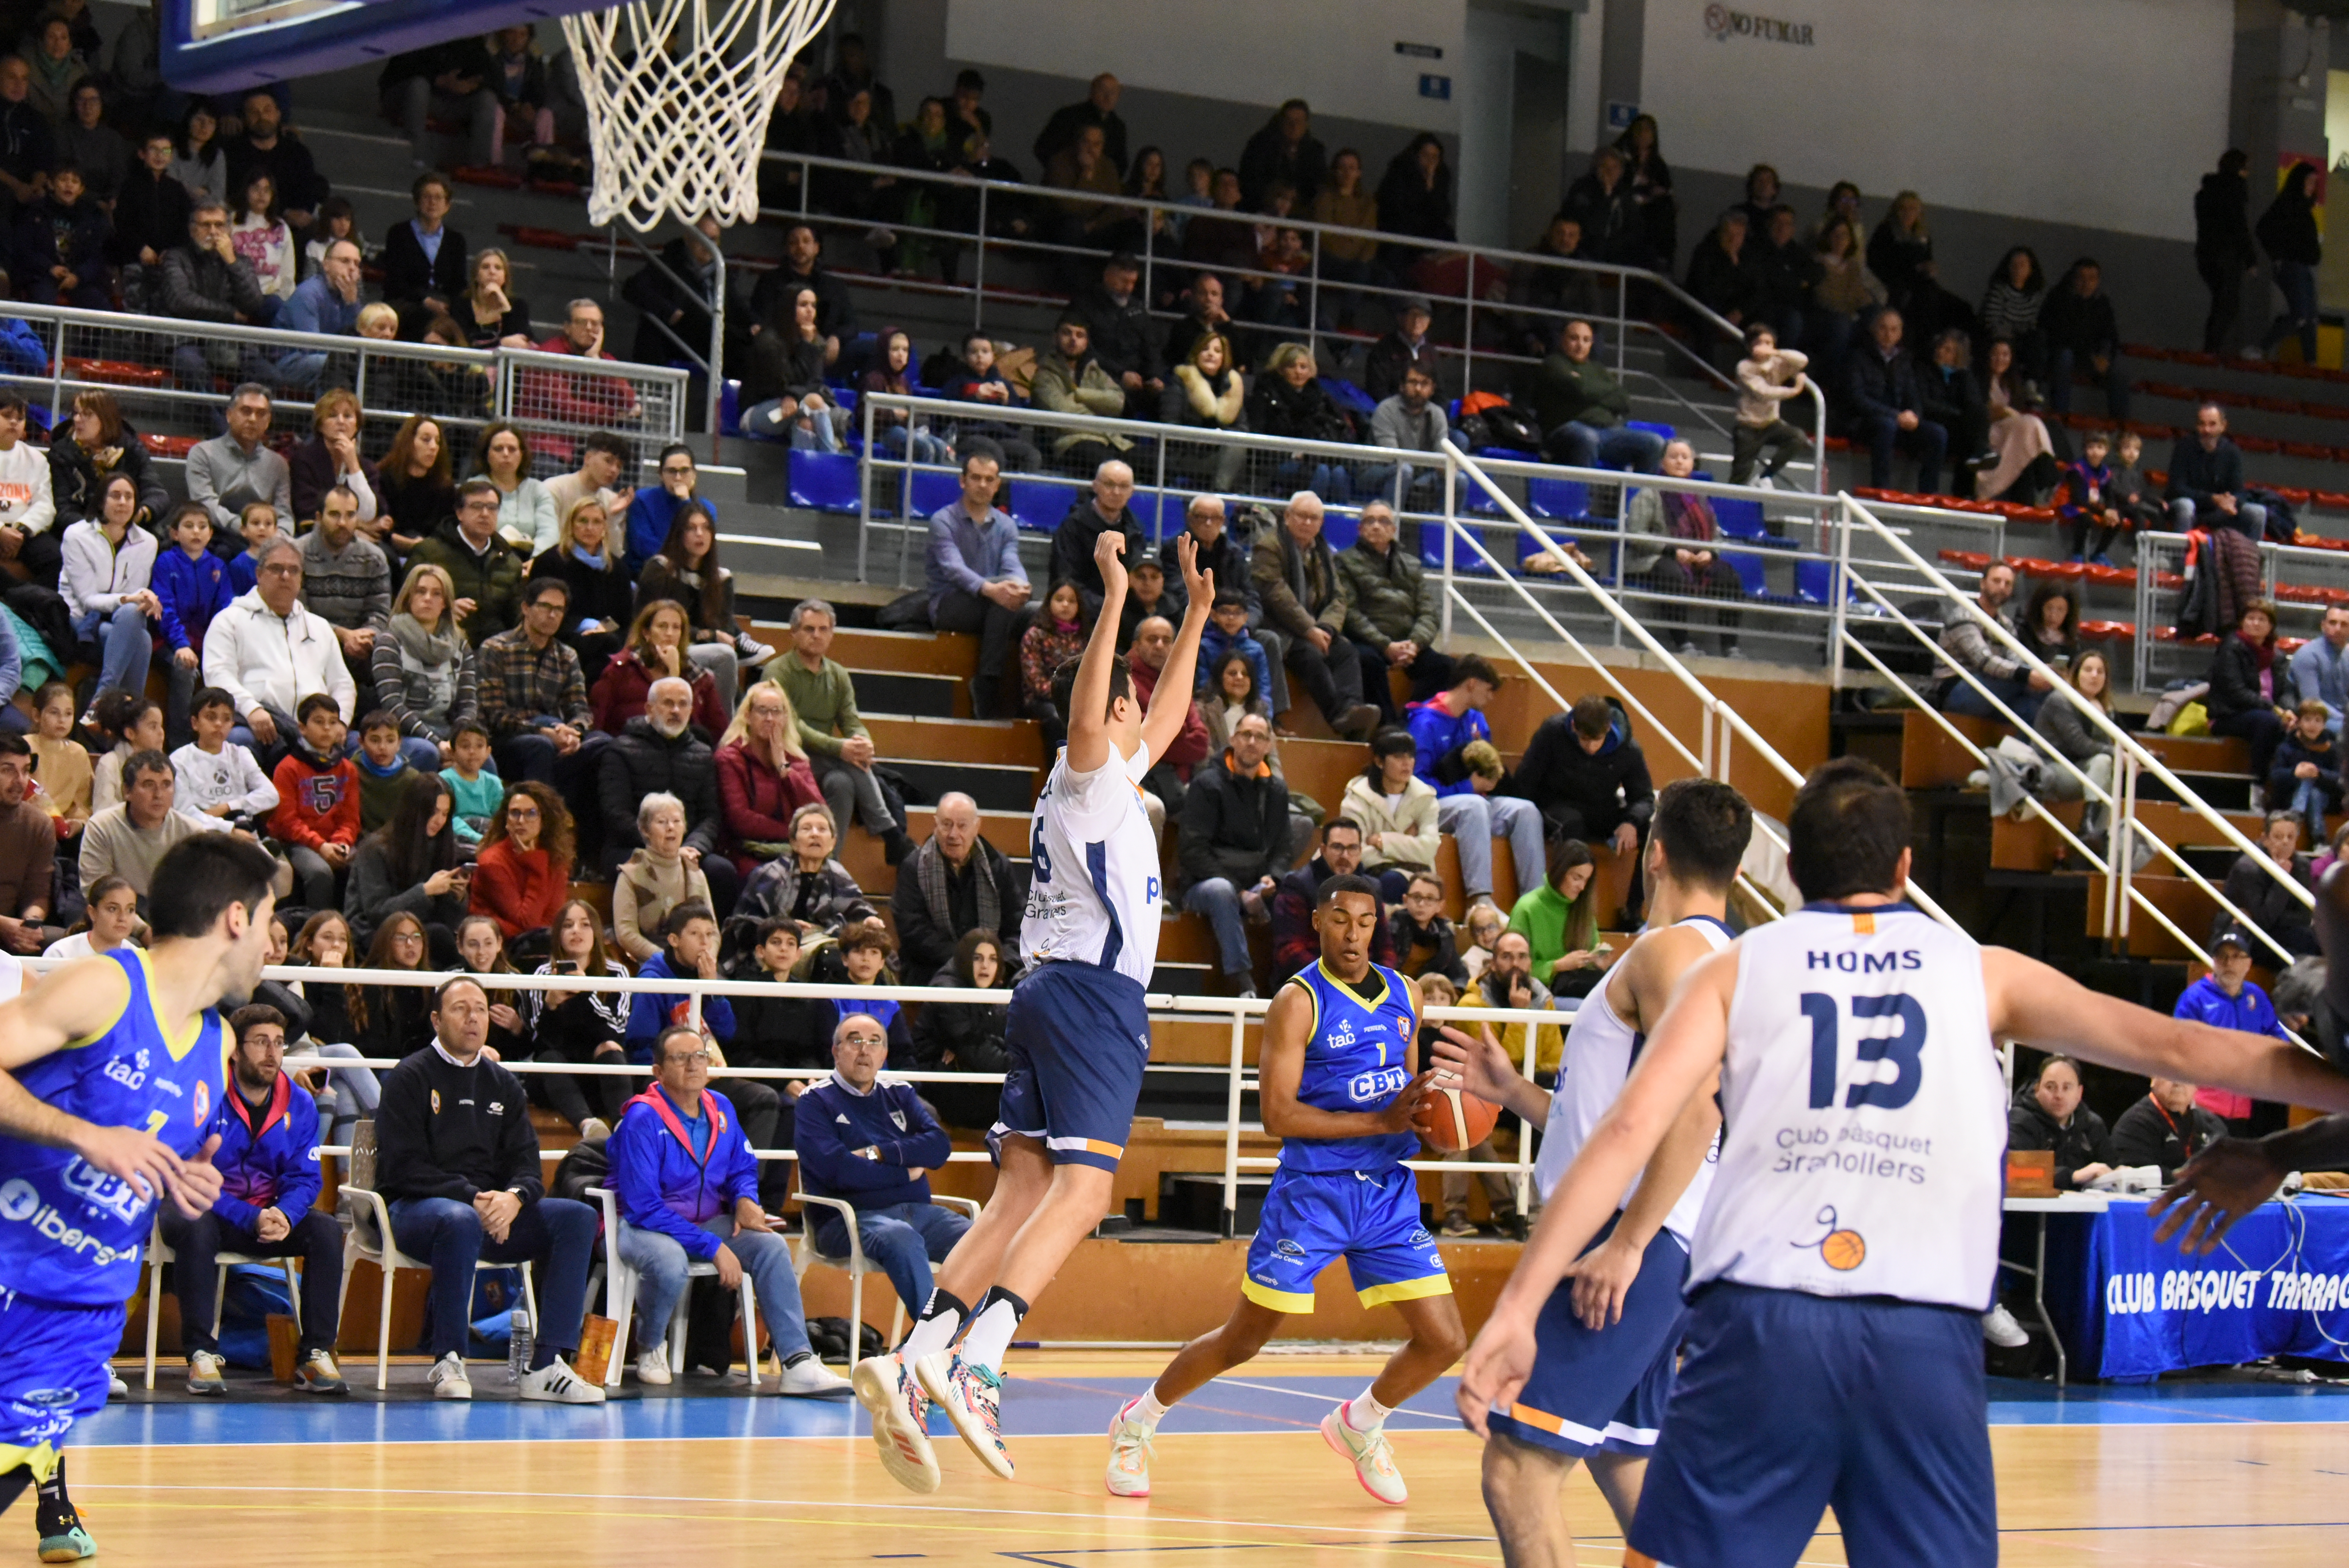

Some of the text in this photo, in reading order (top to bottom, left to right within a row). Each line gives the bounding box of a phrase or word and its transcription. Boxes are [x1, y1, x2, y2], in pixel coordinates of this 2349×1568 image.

[1755, 16, 1814, 45] FUMAR
[312, 775, 337, 815] 5
[1807, 950, 1922, 973] HOMS
[1327, 1033, 1356, 1049] tac
[1376, 1042, 1387, 1067] 1
[1800, 992, 1927, 1109] 13
[1351, 1068, 1404, 1099] CBT
[1284, 1256, 1304, 1266] Center
[2107, 1272, 2156, 1315] CLUB
[2161, 1270, 2262, 1315] BASQUET
